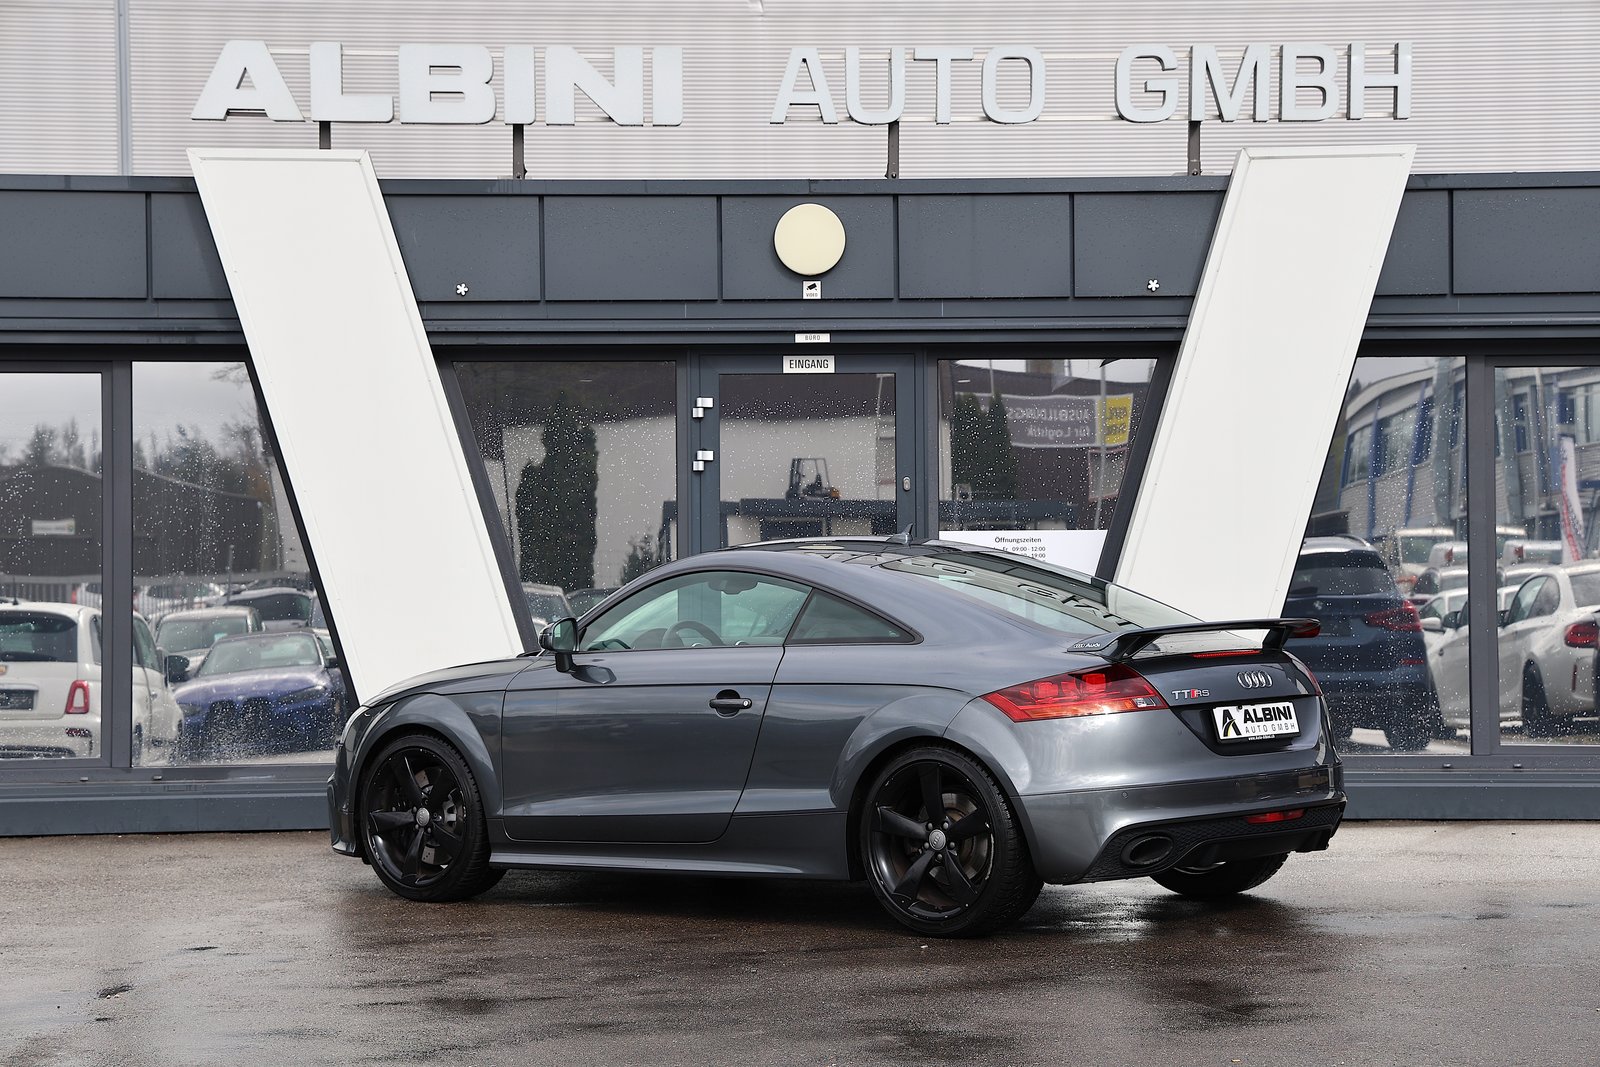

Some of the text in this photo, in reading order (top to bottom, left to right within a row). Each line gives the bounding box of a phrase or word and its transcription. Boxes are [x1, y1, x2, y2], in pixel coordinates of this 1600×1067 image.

[190, 40, 1412, 126] ALBINI AUTO GMBH
[789, 359, 829, 369] EINGANG
[994, 536, 1042, 544] Öffnungszeiten
[1243, 705, 1293, 724] ALBINI
[1245, 722, 1296, 734] AUTO GMBH
